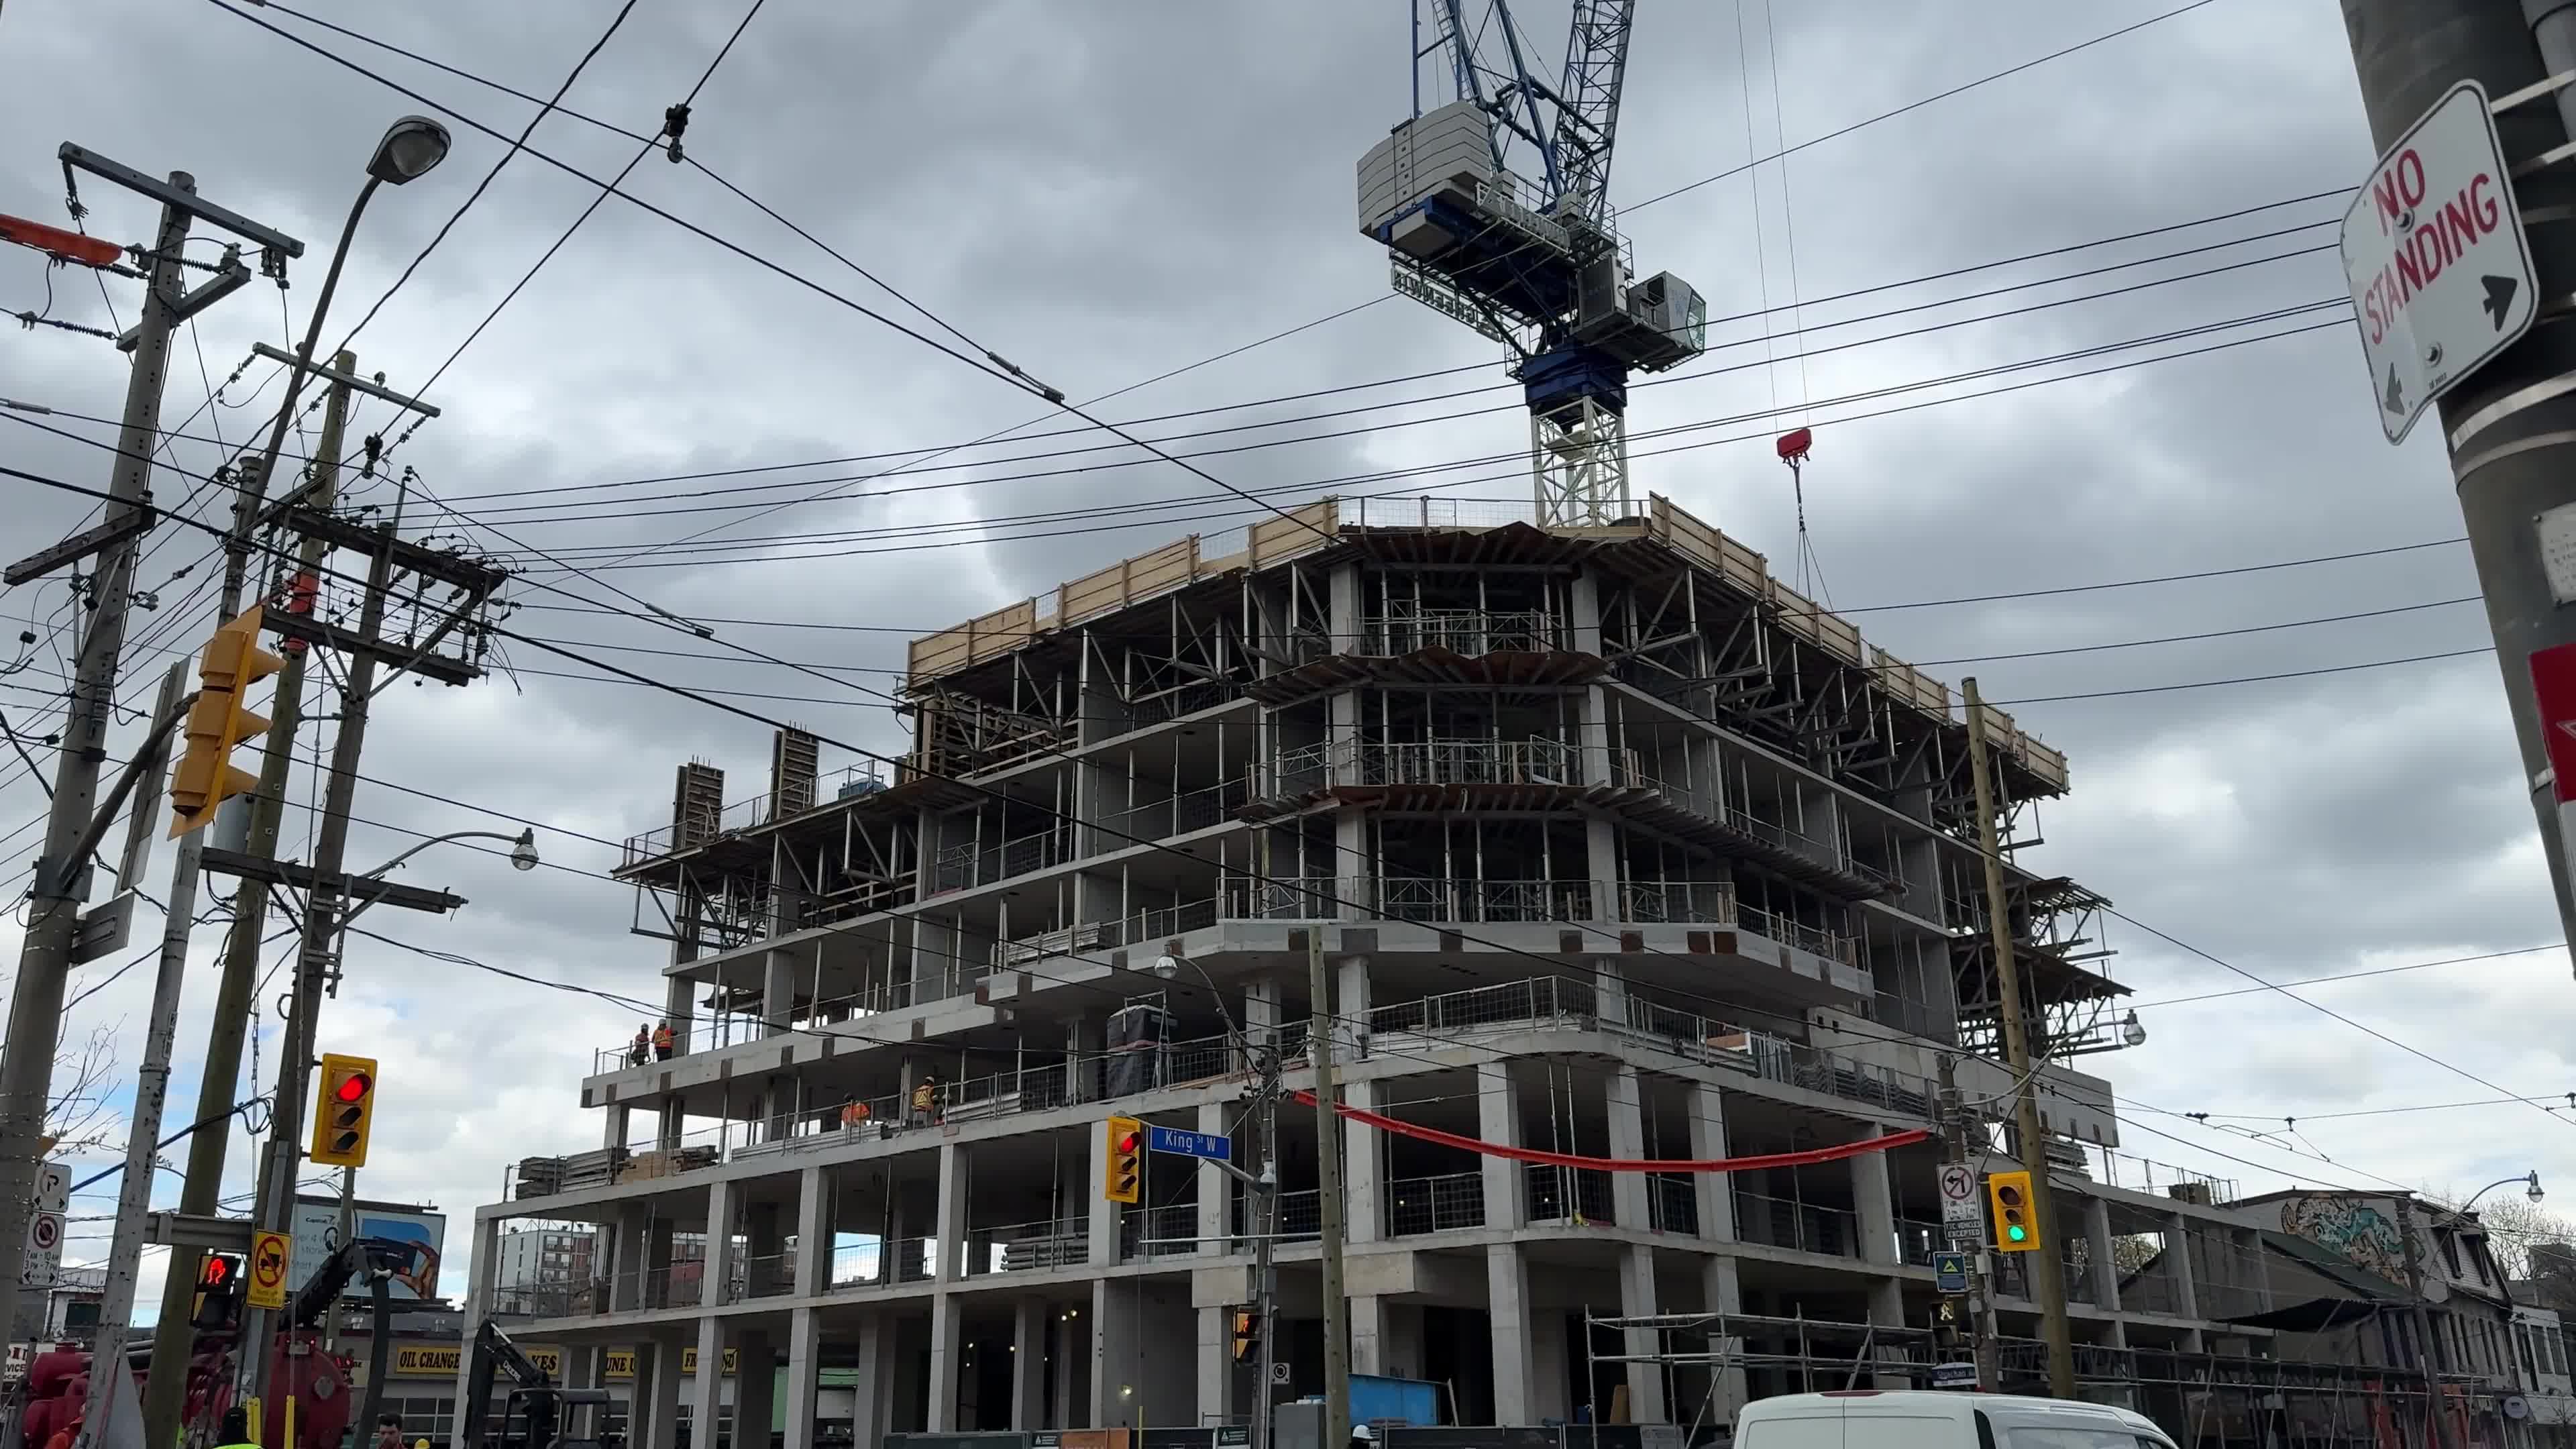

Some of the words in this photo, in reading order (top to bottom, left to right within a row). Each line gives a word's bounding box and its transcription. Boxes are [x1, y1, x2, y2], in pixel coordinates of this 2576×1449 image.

[2373, 149, 2425, 237] NO
[2365, 173, 2498, 345] STANDING
[1165, 1130, 1193, 1153] King
[1207, 1136, 1216, 1152] W
[400, 1351, 416, 1368] OIL
